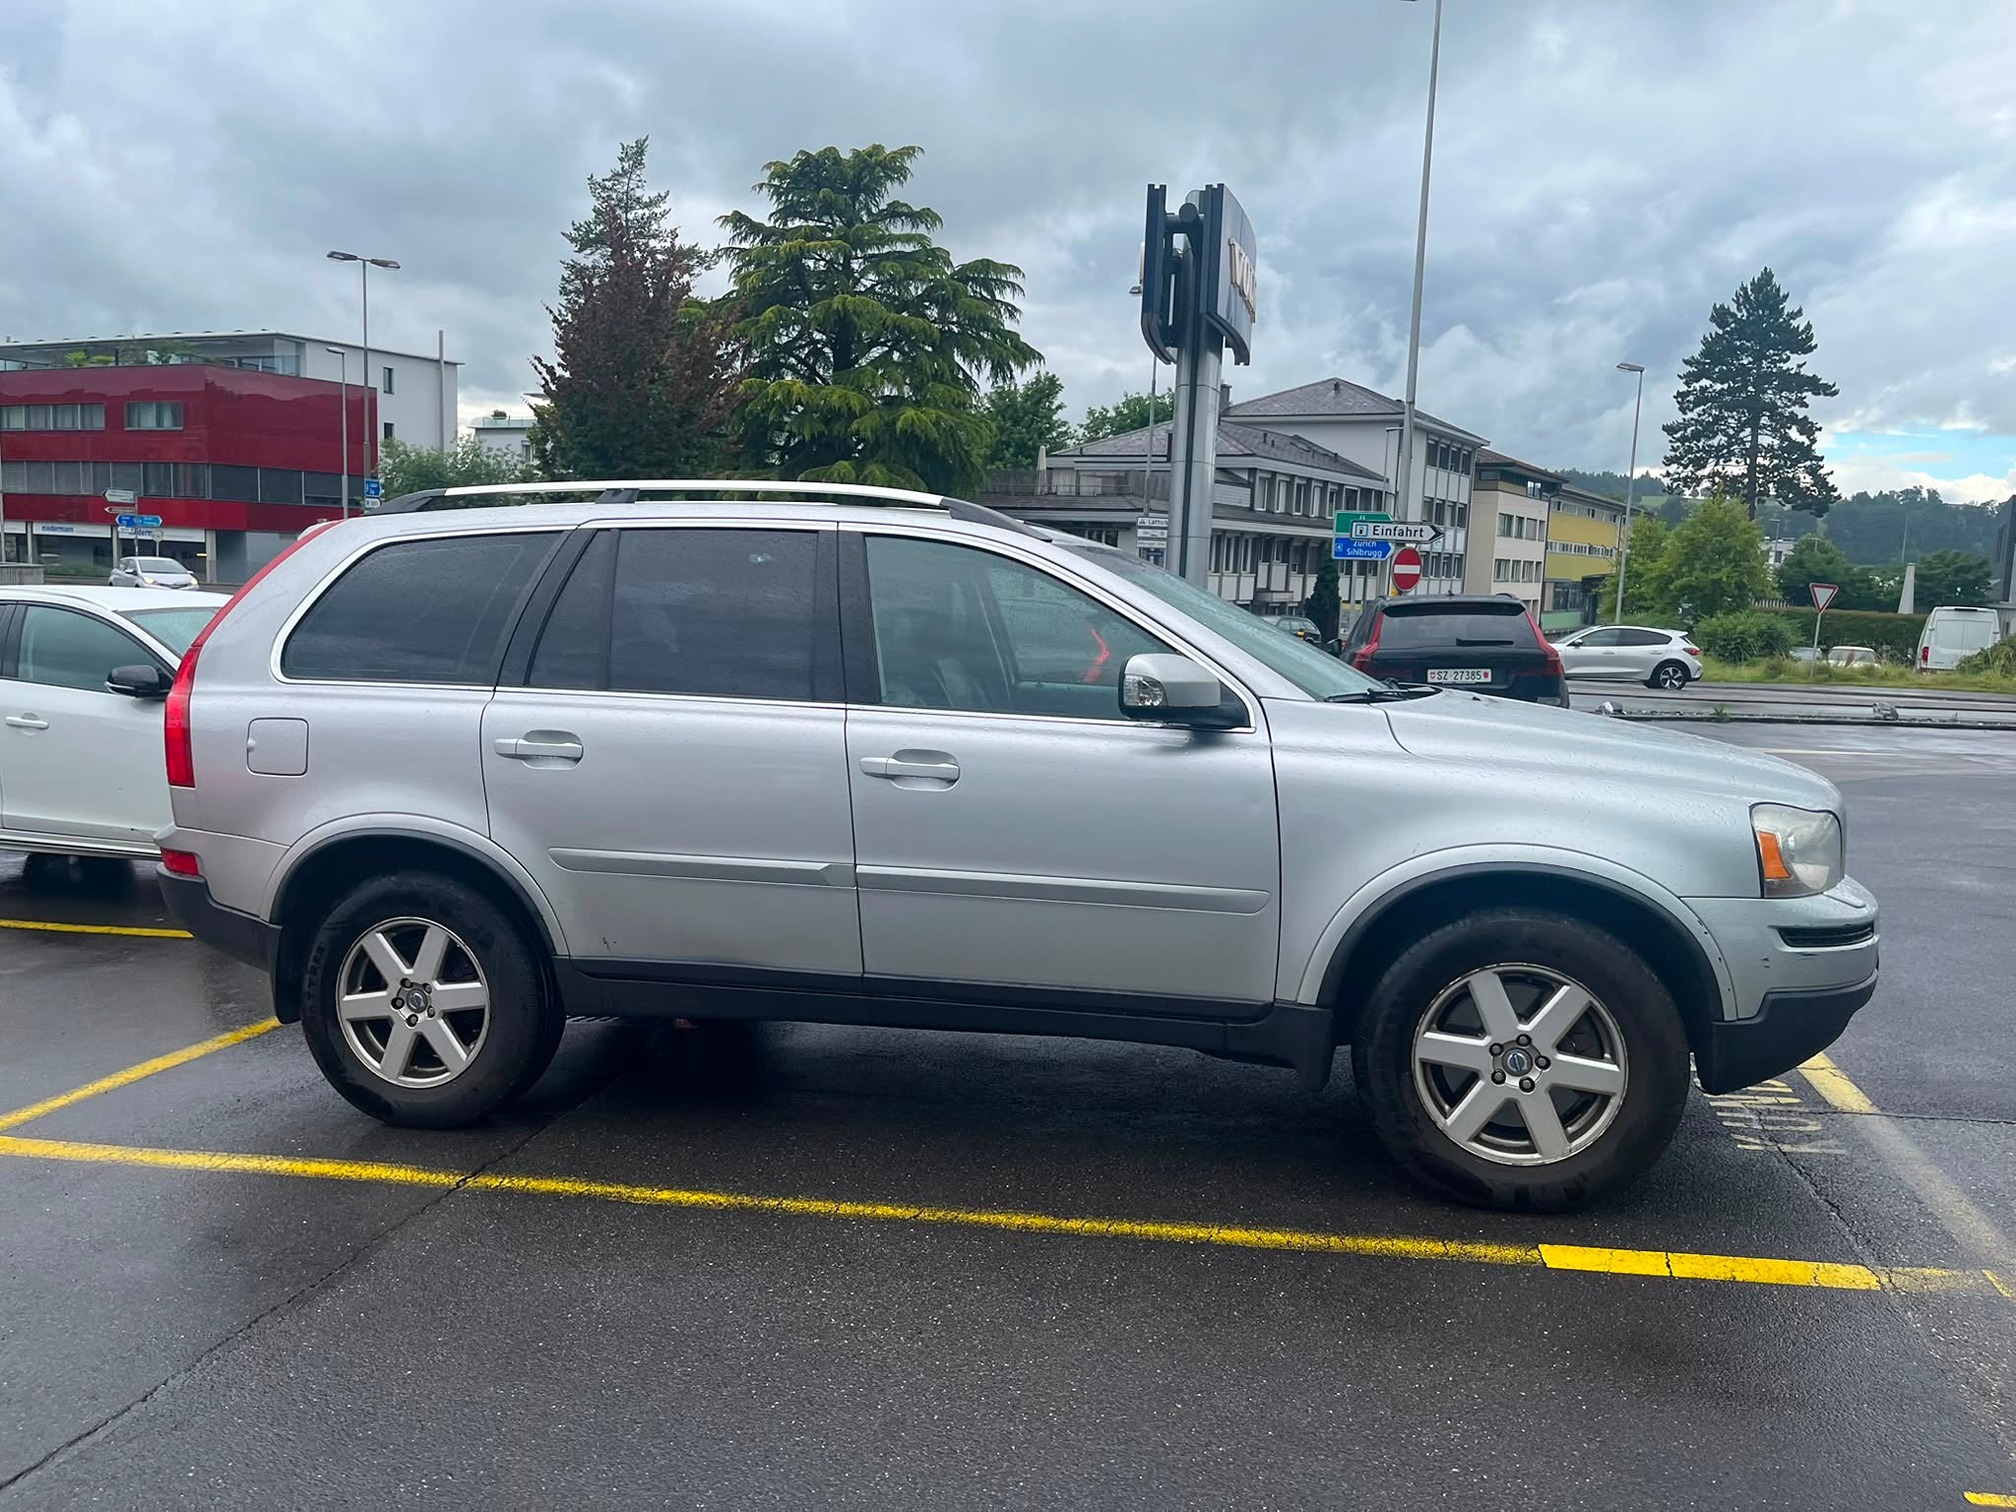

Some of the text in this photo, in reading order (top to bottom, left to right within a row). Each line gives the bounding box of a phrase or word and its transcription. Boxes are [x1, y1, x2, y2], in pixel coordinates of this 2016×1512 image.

[1372, 525, 1424, 538] Einfahrt
[1346, 547, 1382, 558] Sihlbrugg
[1436, 670, 1481, 680] SZ 27385
